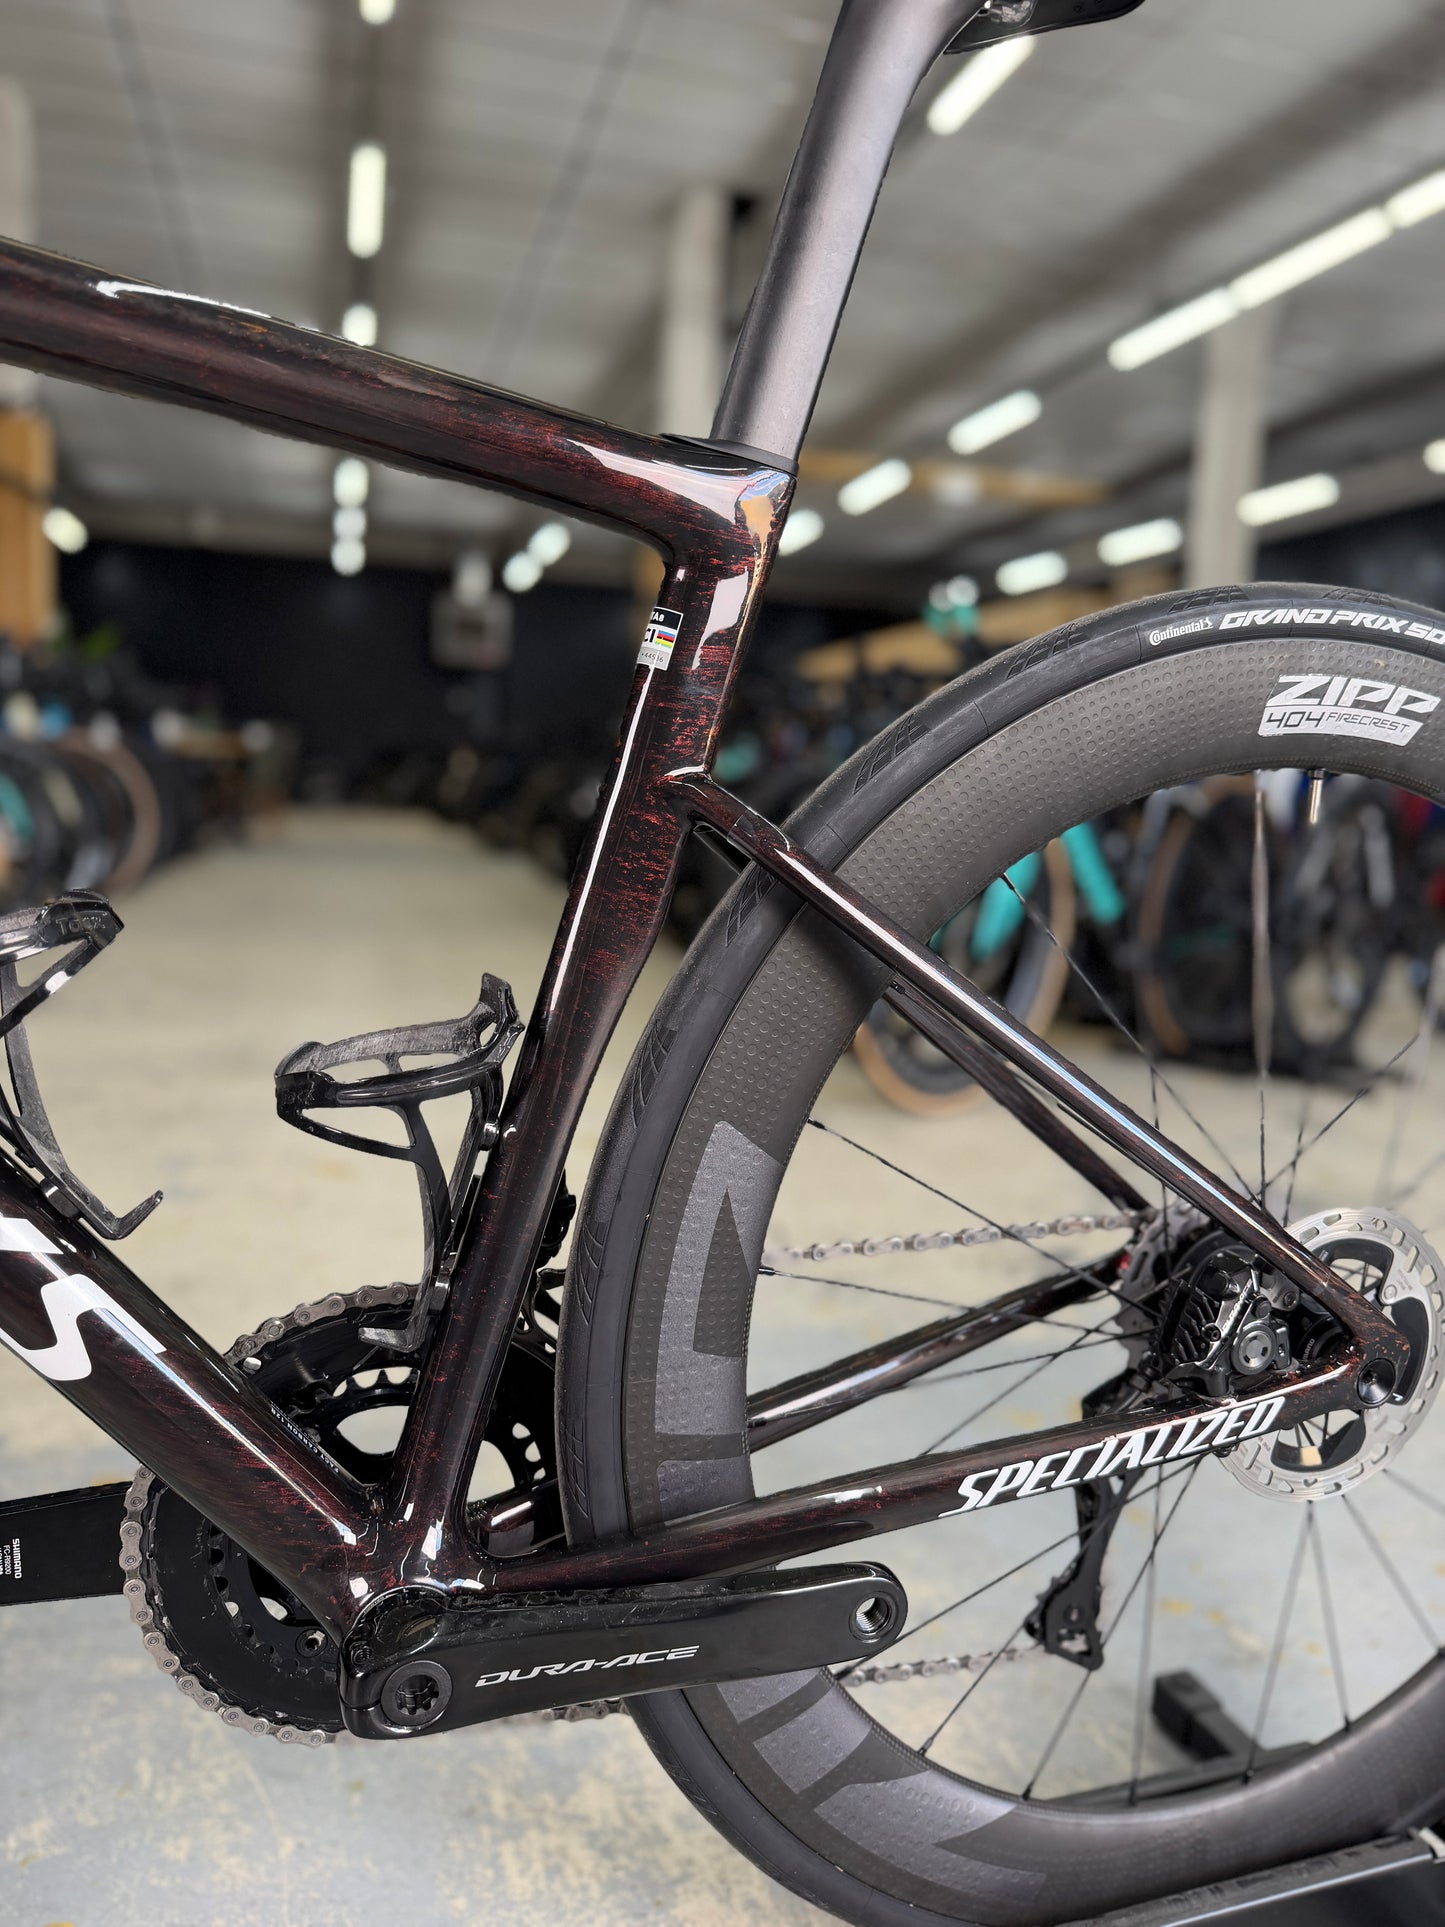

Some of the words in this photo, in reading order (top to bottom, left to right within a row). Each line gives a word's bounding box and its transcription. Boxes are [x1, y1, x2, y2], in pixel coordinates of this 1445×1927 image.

[1149, 619, 1206, 646] Continental
[1219, 608, 1327, 630] GRAND
[1328, 610, 1409, 634] PRIX
[1266, 674, 1441, 716] ZIPP
[1266, 711, 1326, 728] 404
[1326, 711, 1410, 733] FIRECREST
[287, 1422, 318, 1454] CARBON
[938, 1396, 1285, 1518] SPECIALIZED
[320, 1453, 339, 1473] FACT
[3, 1544, 12, 1575] FC-R9200
[12, 1538, 22, 1579] SHIMANO
[475, 1645, 700, 1687] DURA-ACE
